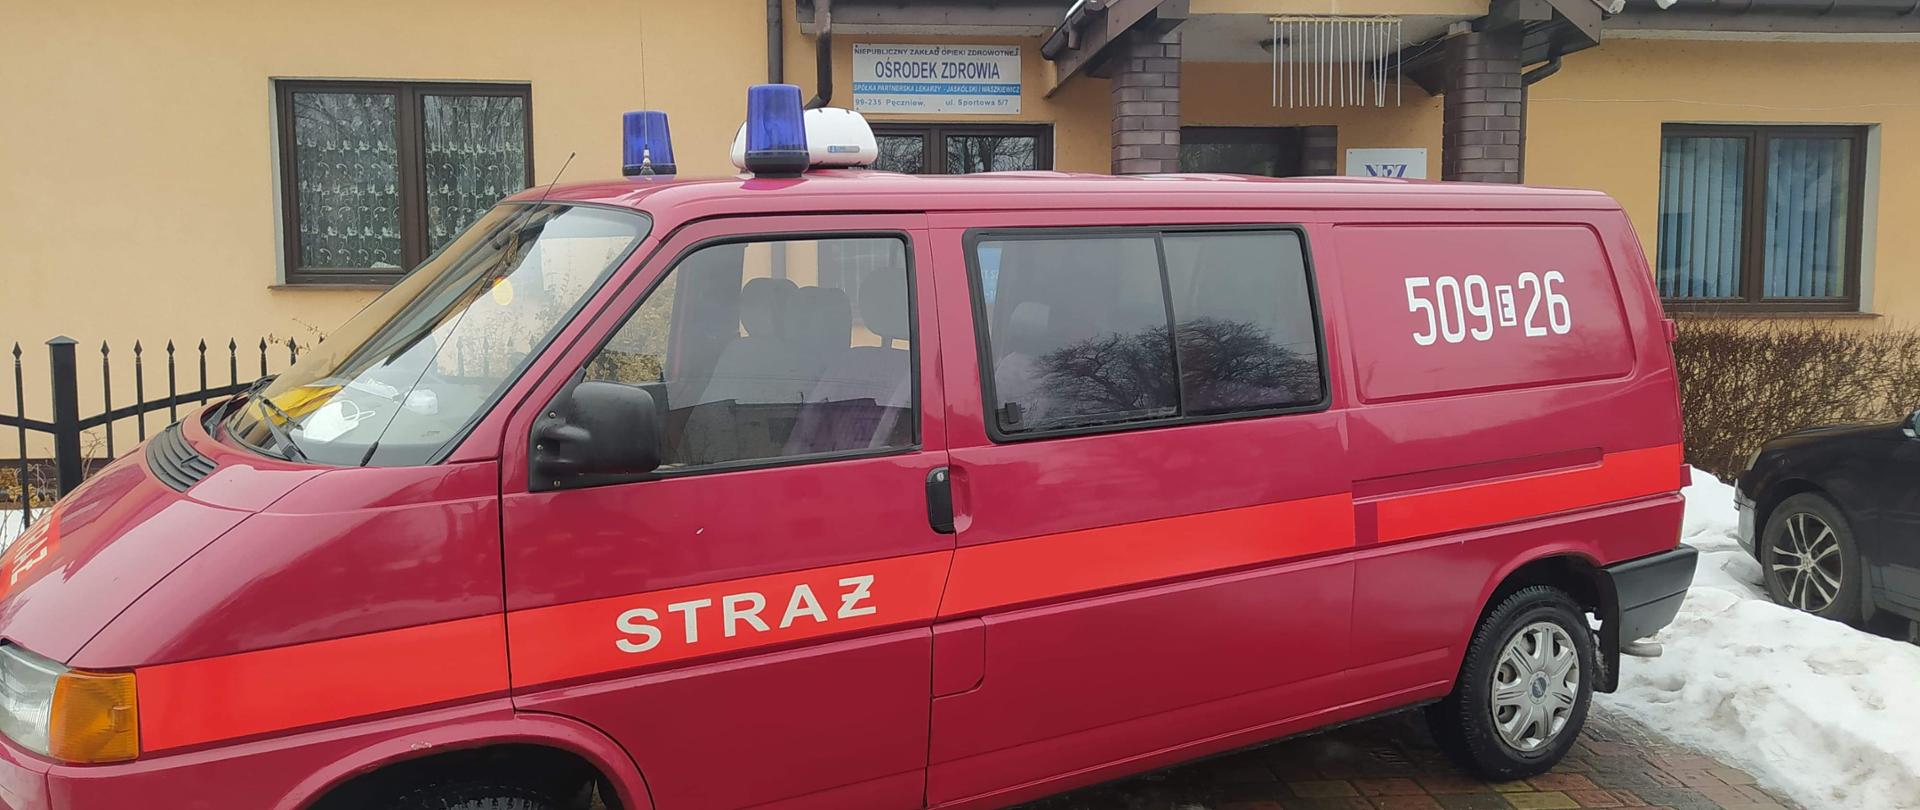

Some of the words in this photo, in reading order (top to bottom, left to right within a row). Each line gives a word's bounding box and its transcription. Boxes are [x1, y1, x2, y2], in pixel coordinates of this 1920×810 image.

[875, 57, 938, 79] OŚRODEK
[941, 62, 1000, 79] ZDROWIA
[958, 99, 995, 107] Sportowa
[615, 574, 877, 653] STRAŻ
